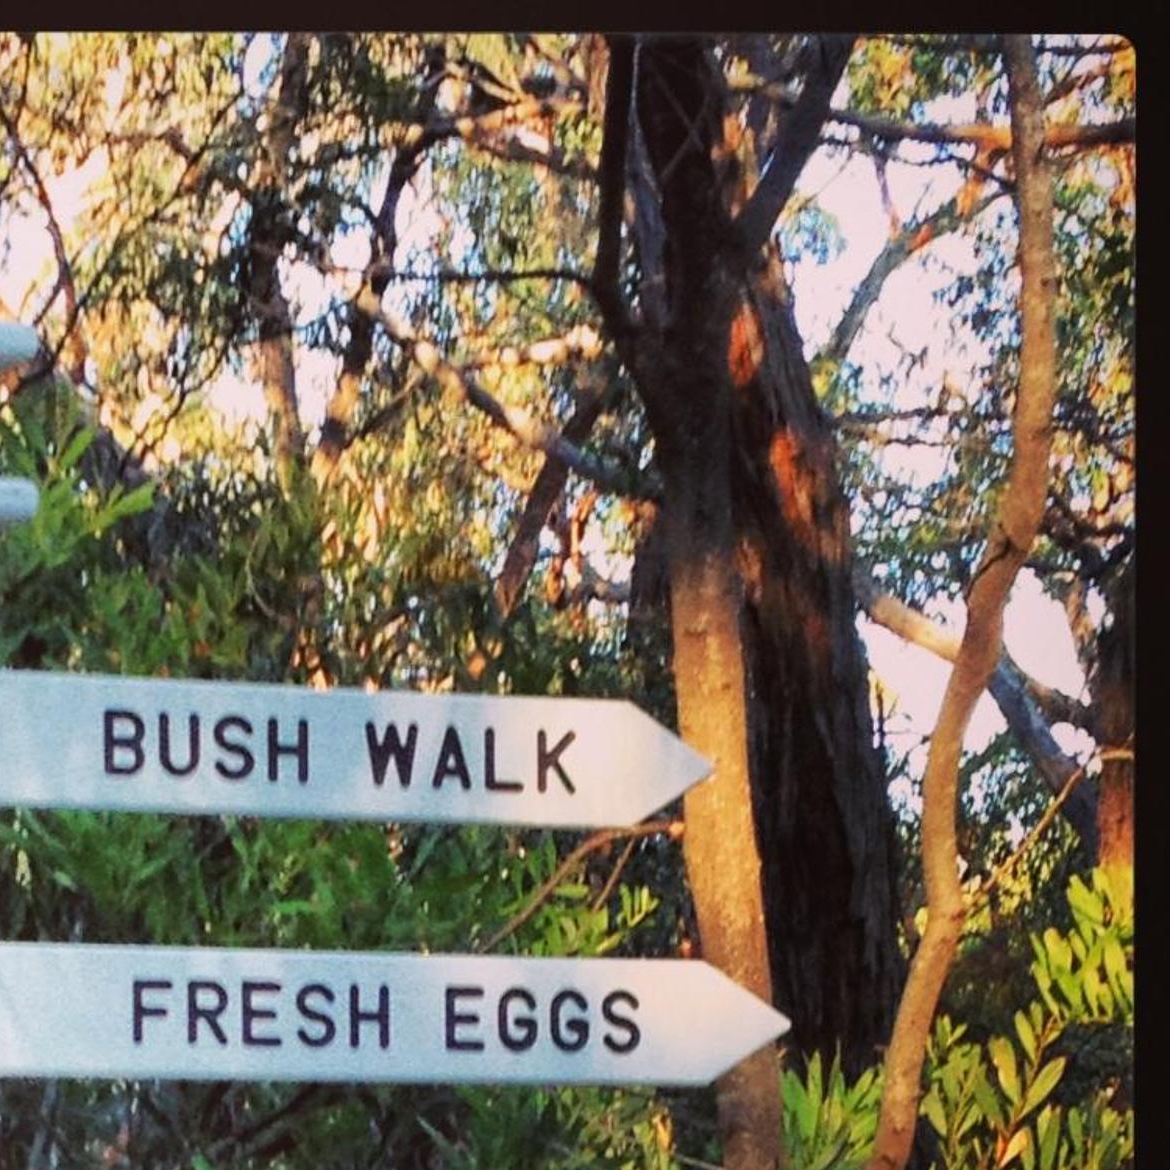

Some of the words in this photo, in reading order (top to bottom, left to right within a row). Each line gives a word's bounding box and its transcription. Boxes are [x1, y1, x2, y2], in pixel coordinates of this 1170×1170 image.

[104, 709, 308, 784] BUSH
[365, 720, 575, 794] WALK
[133, 980, 389, 1050] FRESH
[445, 987, 640, 1054] EGGS
